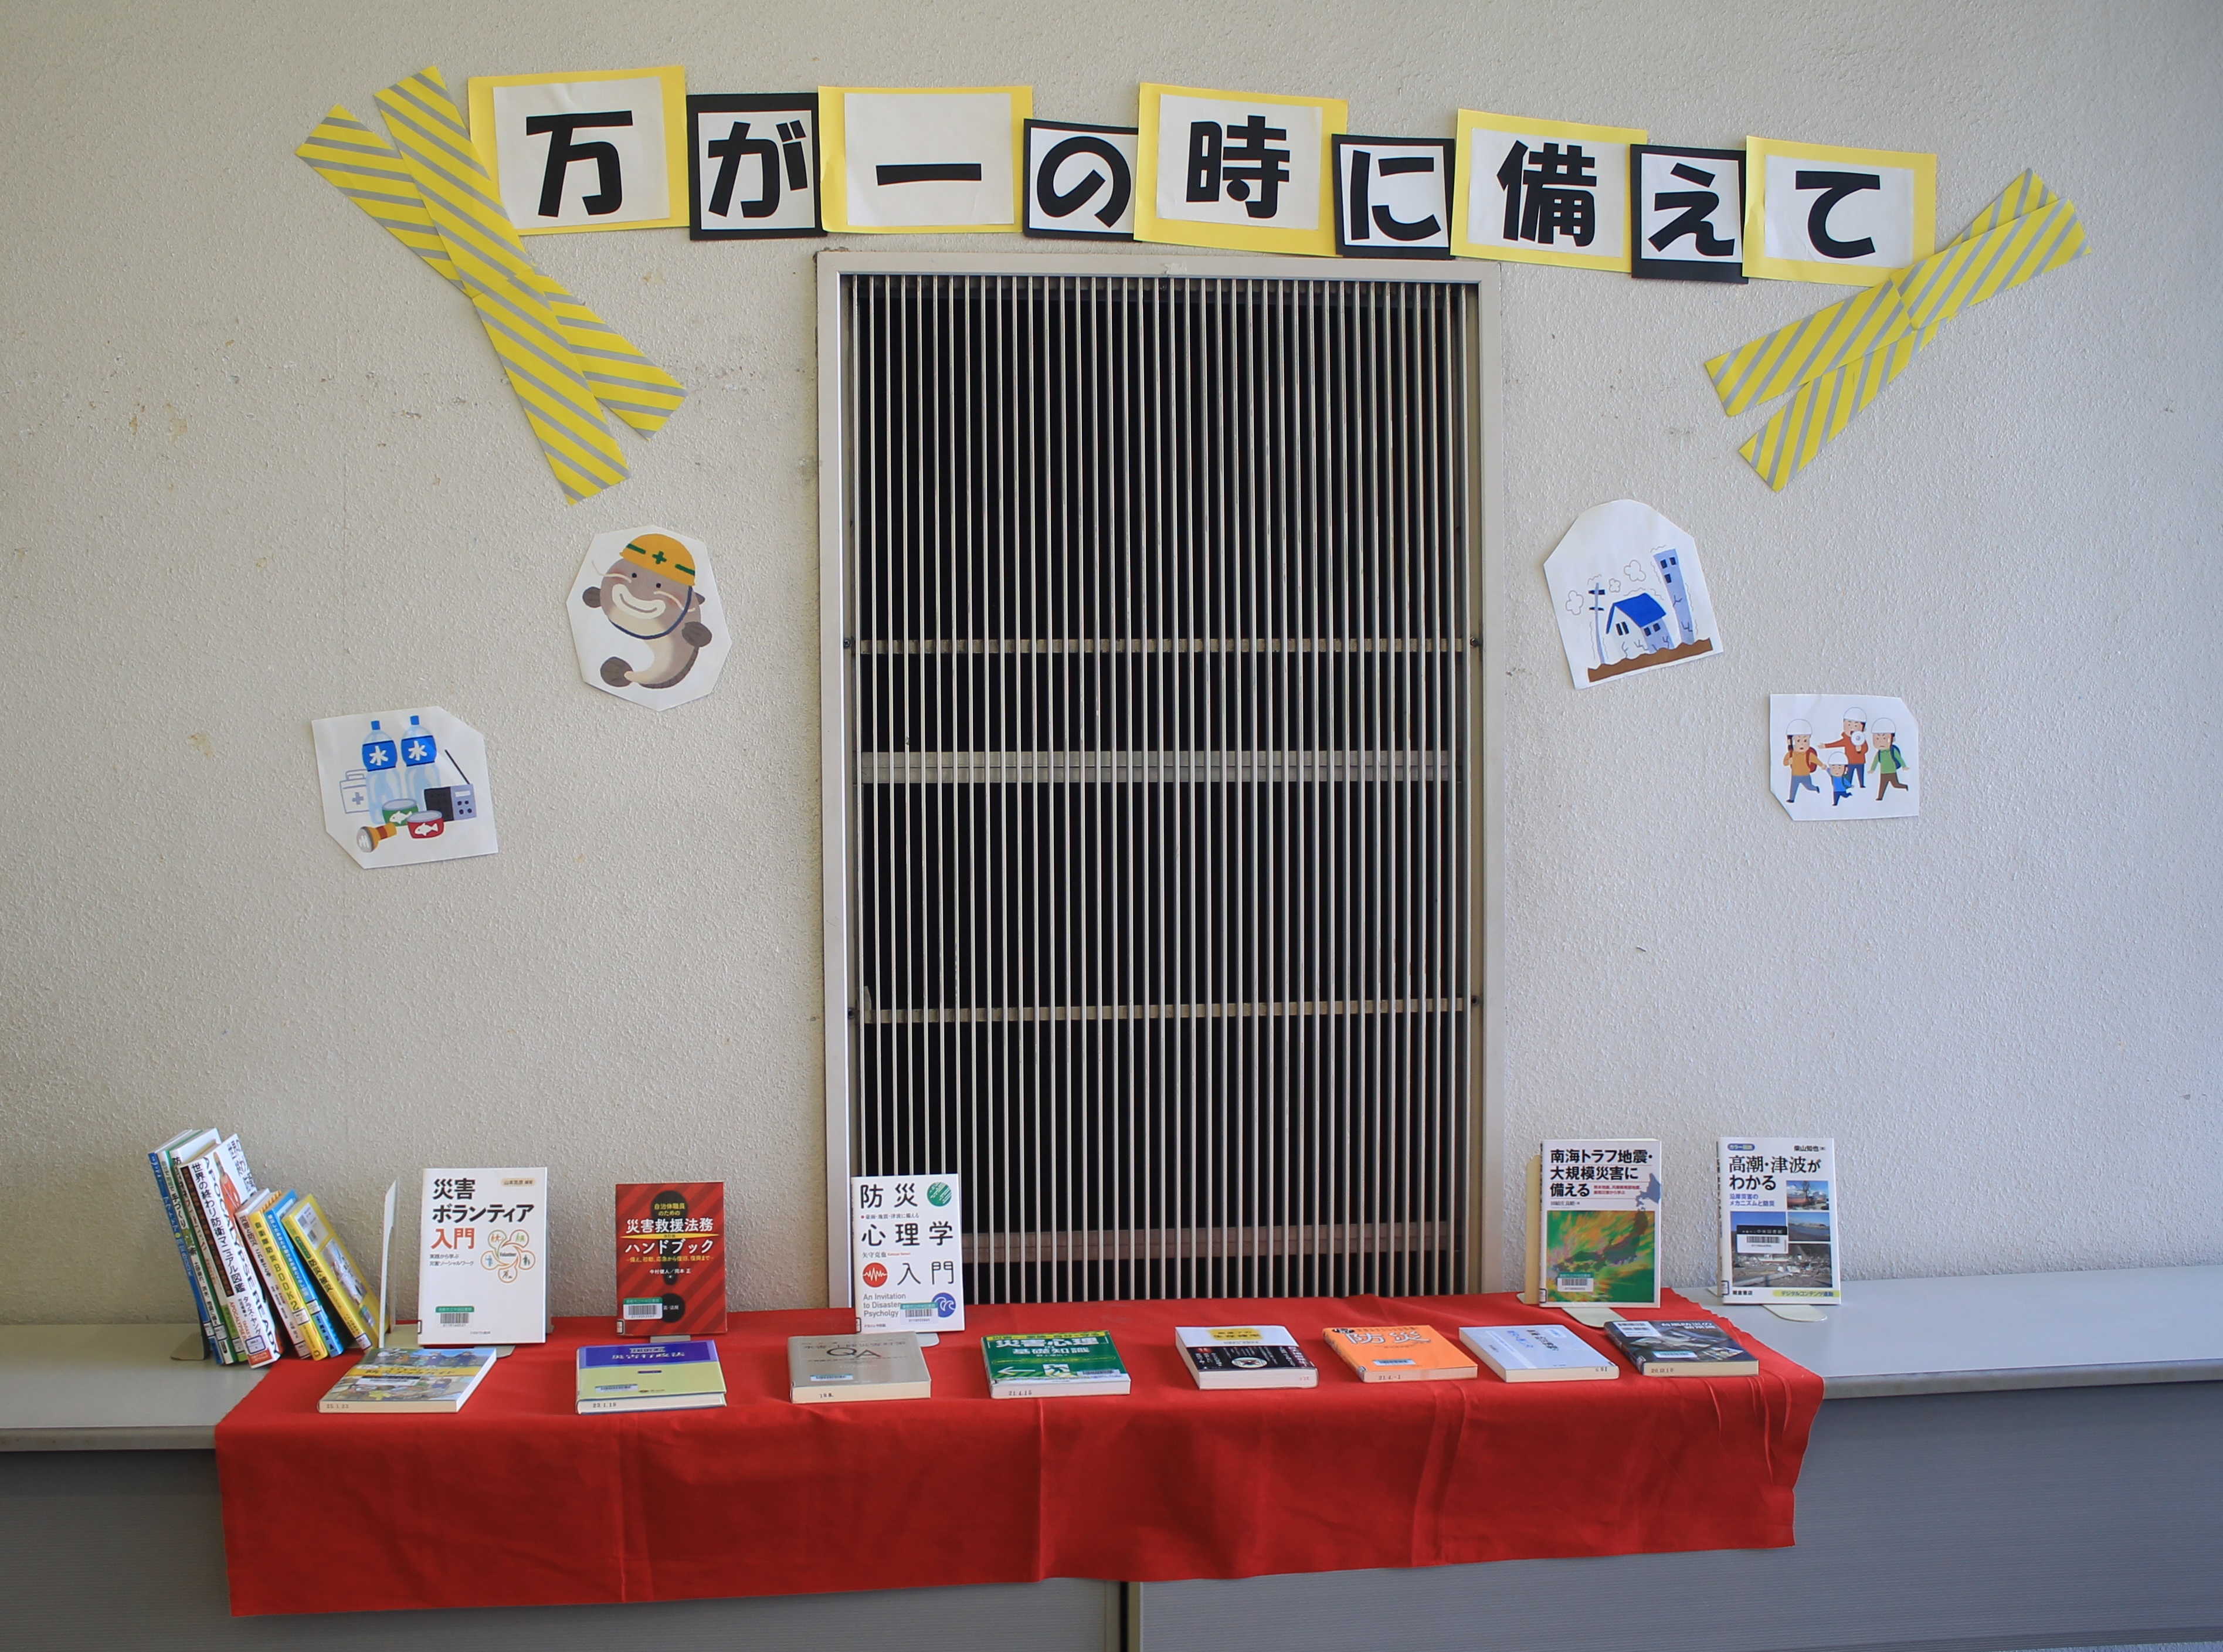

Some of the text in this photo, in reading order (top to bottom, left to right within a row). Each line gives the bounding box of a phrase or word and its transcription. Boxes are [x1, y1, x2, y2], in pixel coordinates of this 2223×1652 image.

[526, 110, 1881, 259] 万が一の時に備えて
[369, 745, 388, 765] 水
[408, 740, 427, 761] 水
[1550, 1166, 1638, 1180] 大規模災害に
[1729, 1155, 1821, 1173] 高潮・津波が
[432, 1178, 476, 1200] 災害
[1550, 1183, 1590, 1197] 備える
[1729, 1175, 1776, 1190] わかる
[860, 1183, 918, 1209] 防災
[432, 1204, 534, 1223] ボランティア
[191, 1161, 246, 1294] 世界の終わり防衛マニュアル図鑑
[626, 1217, 714, 1234] 災害救援法務
[861, 1220, 953, 1246] 心理学
[430, 1228, 474, 1249] 入門
[625, 1239, 714, 1254] ハンドブック
[897, 1261, 954, 1285] 入門
[864, 1310, 899, 1318] Psycholgy
[996, 1337, 1099, 1348] 災害心理
[1345, 1331, 1431, 1344] 防災
